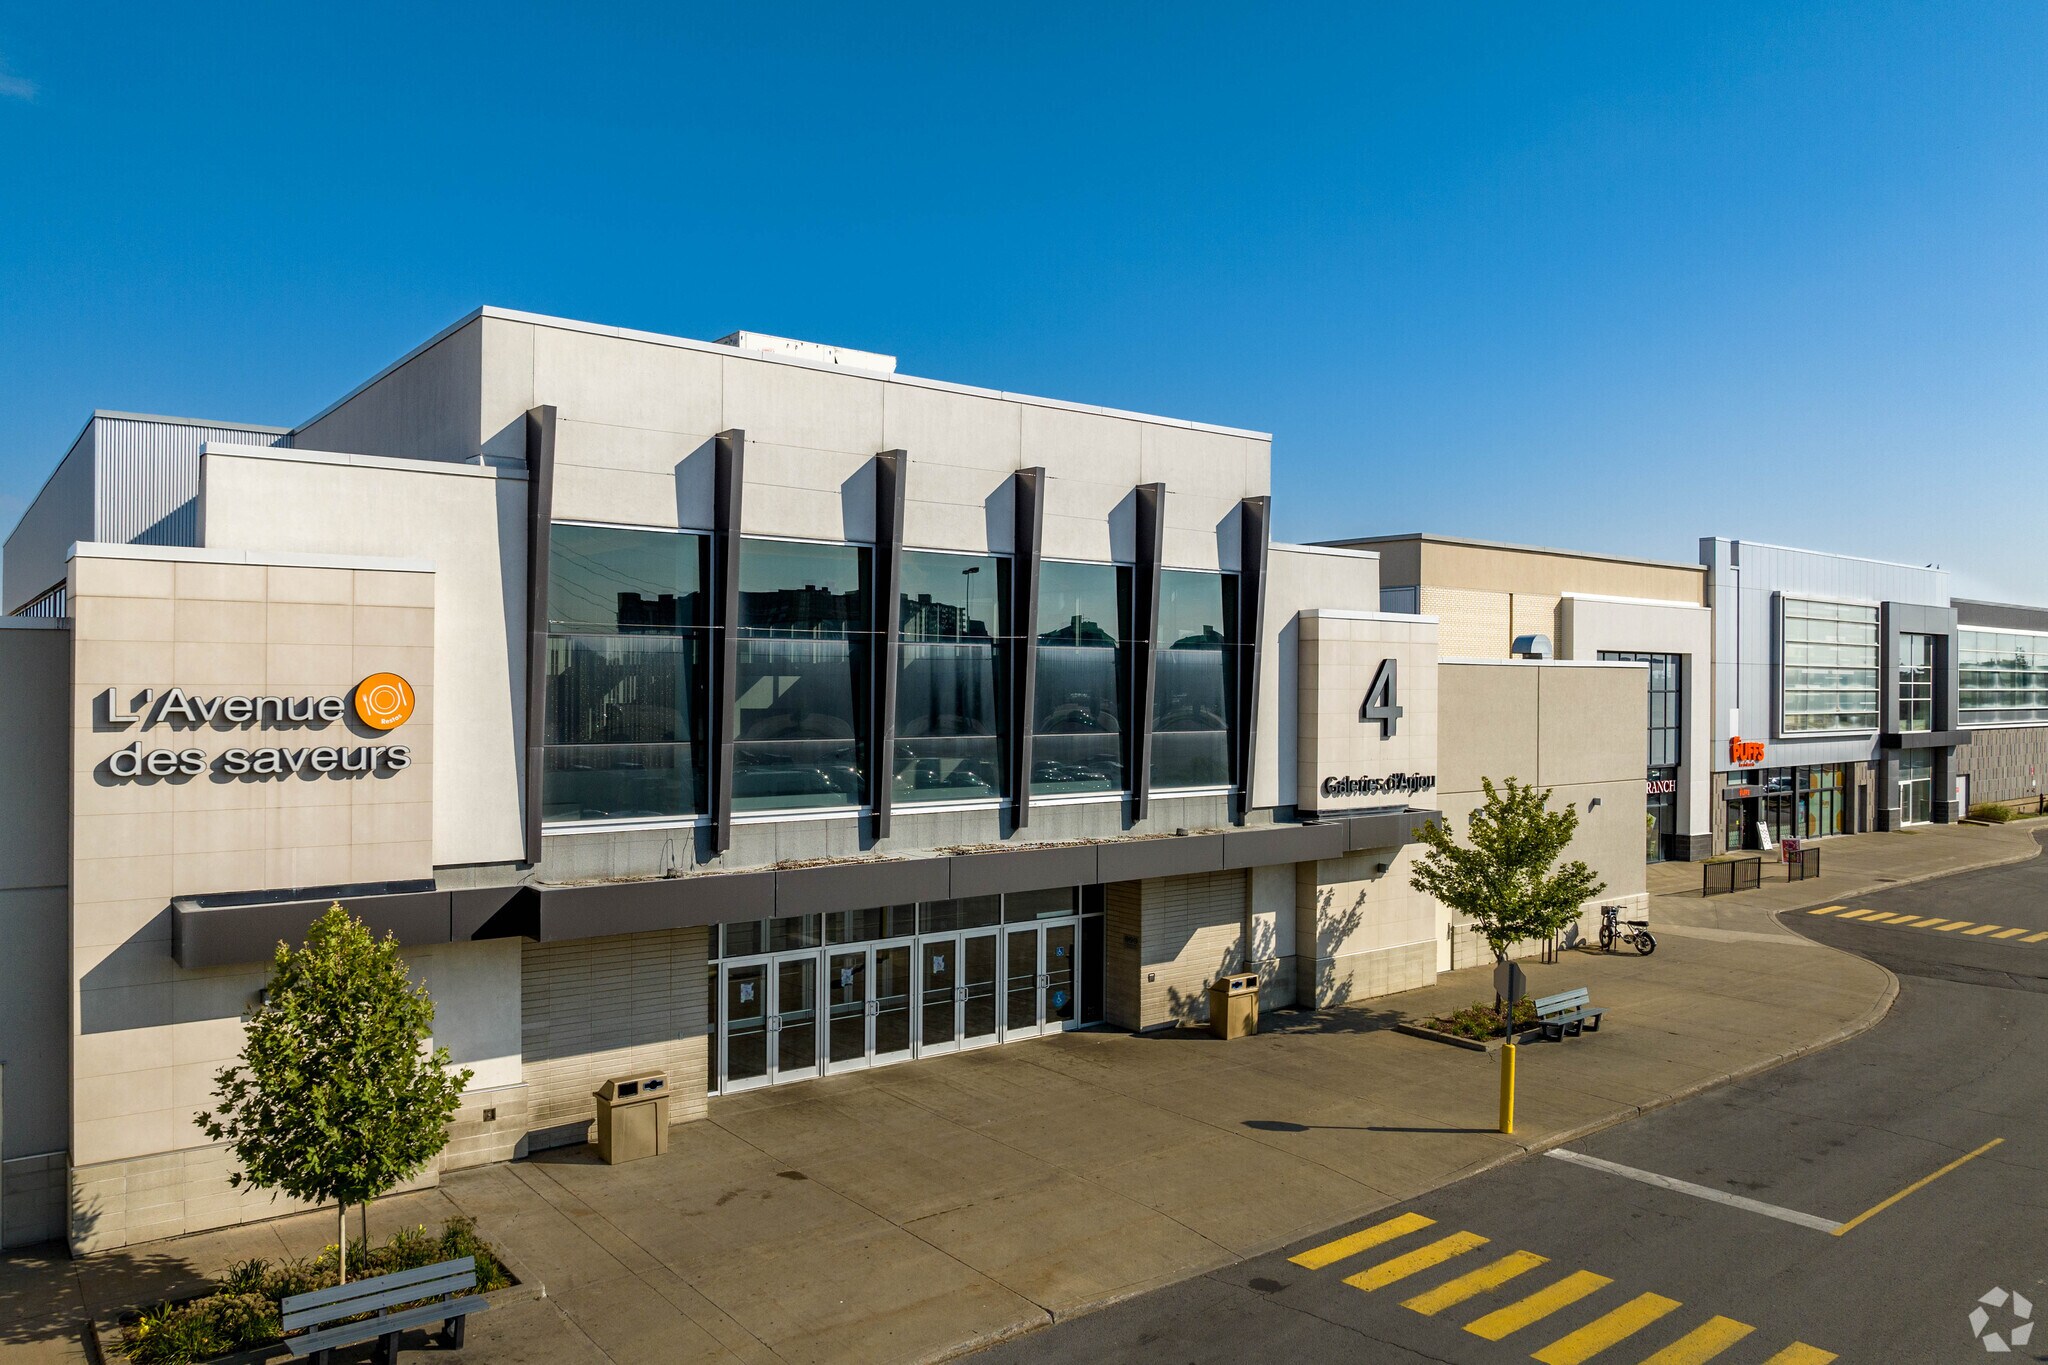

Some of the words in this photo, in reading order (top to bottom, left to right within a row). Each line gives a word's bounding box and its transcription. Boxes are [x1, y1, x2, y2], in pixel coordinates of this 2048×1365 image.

[108, 687, 345, 723] L'Avenue
[1362, 658, 1403, 737] 4
[380, 714, 403, 725] Restos
[109, 741, 208, 777] des
[223, 745, 412, 774] saveurs
[1323, 774, 1384, 794] Galeries
[1384, 772, 1436, 795] d'Anjou
